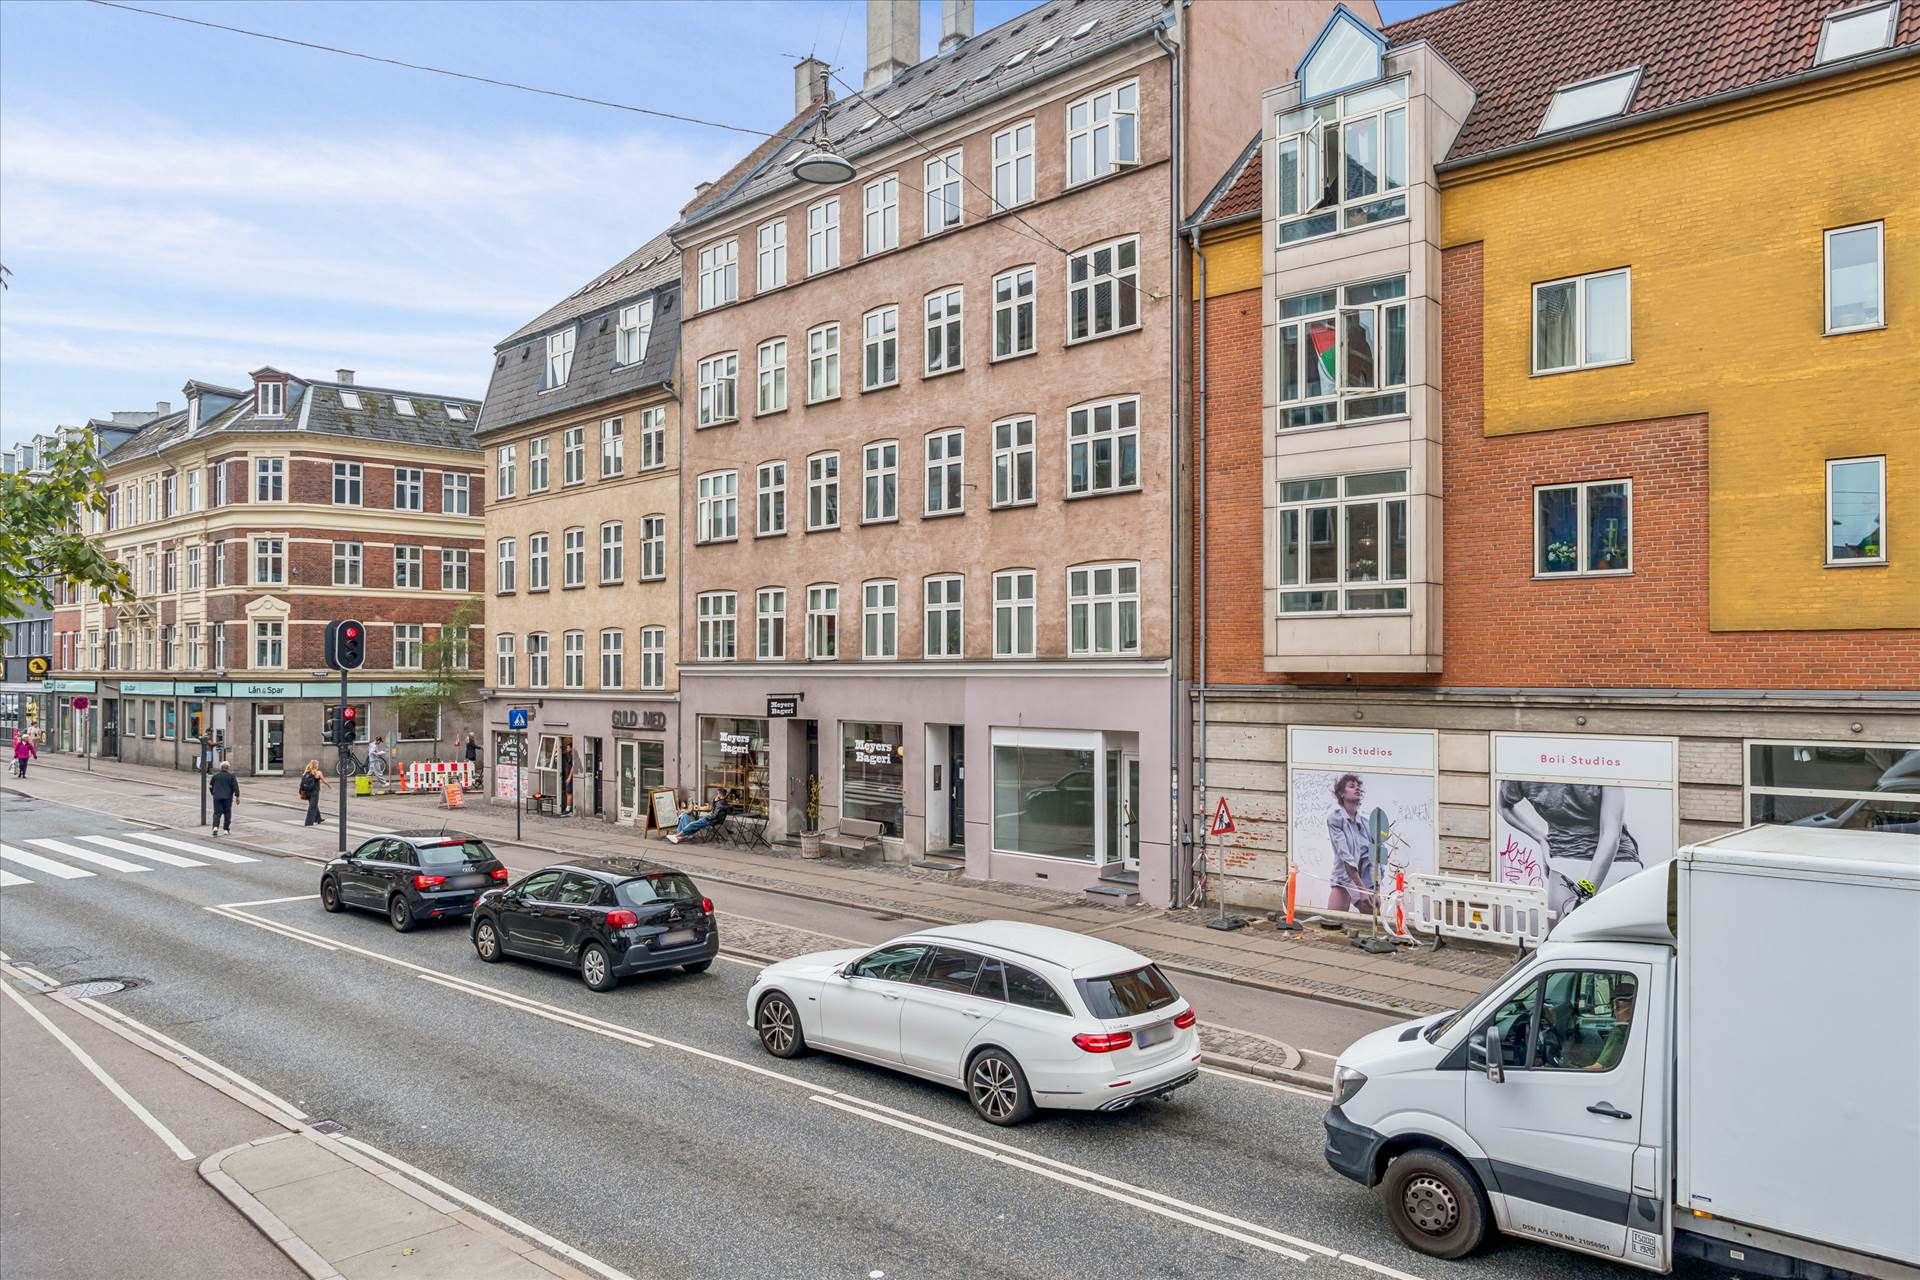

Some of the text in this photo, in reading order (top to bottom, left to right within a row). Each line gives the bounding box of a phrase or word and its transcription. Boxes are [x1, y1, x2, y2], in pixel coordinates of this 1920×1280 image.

[248, 685, 261, 694] Lån
[267, 686, 284, 695] Spar
[770, 701, 794, 709] Meyers
[611, 709, 667, 729] GULD MED
[720, 732, 750, 744] Meyers
[720, 743, 750, 755] Bageri
[854, 739, 893, 752] Meyers
[1327, 745, 1393, 756] Boii Studios
[855, 751, 892, 765] Bageri
[1540, 754, 1621, 767] Boii Studios
[1522, 1223, 1536, 1232] DSN
